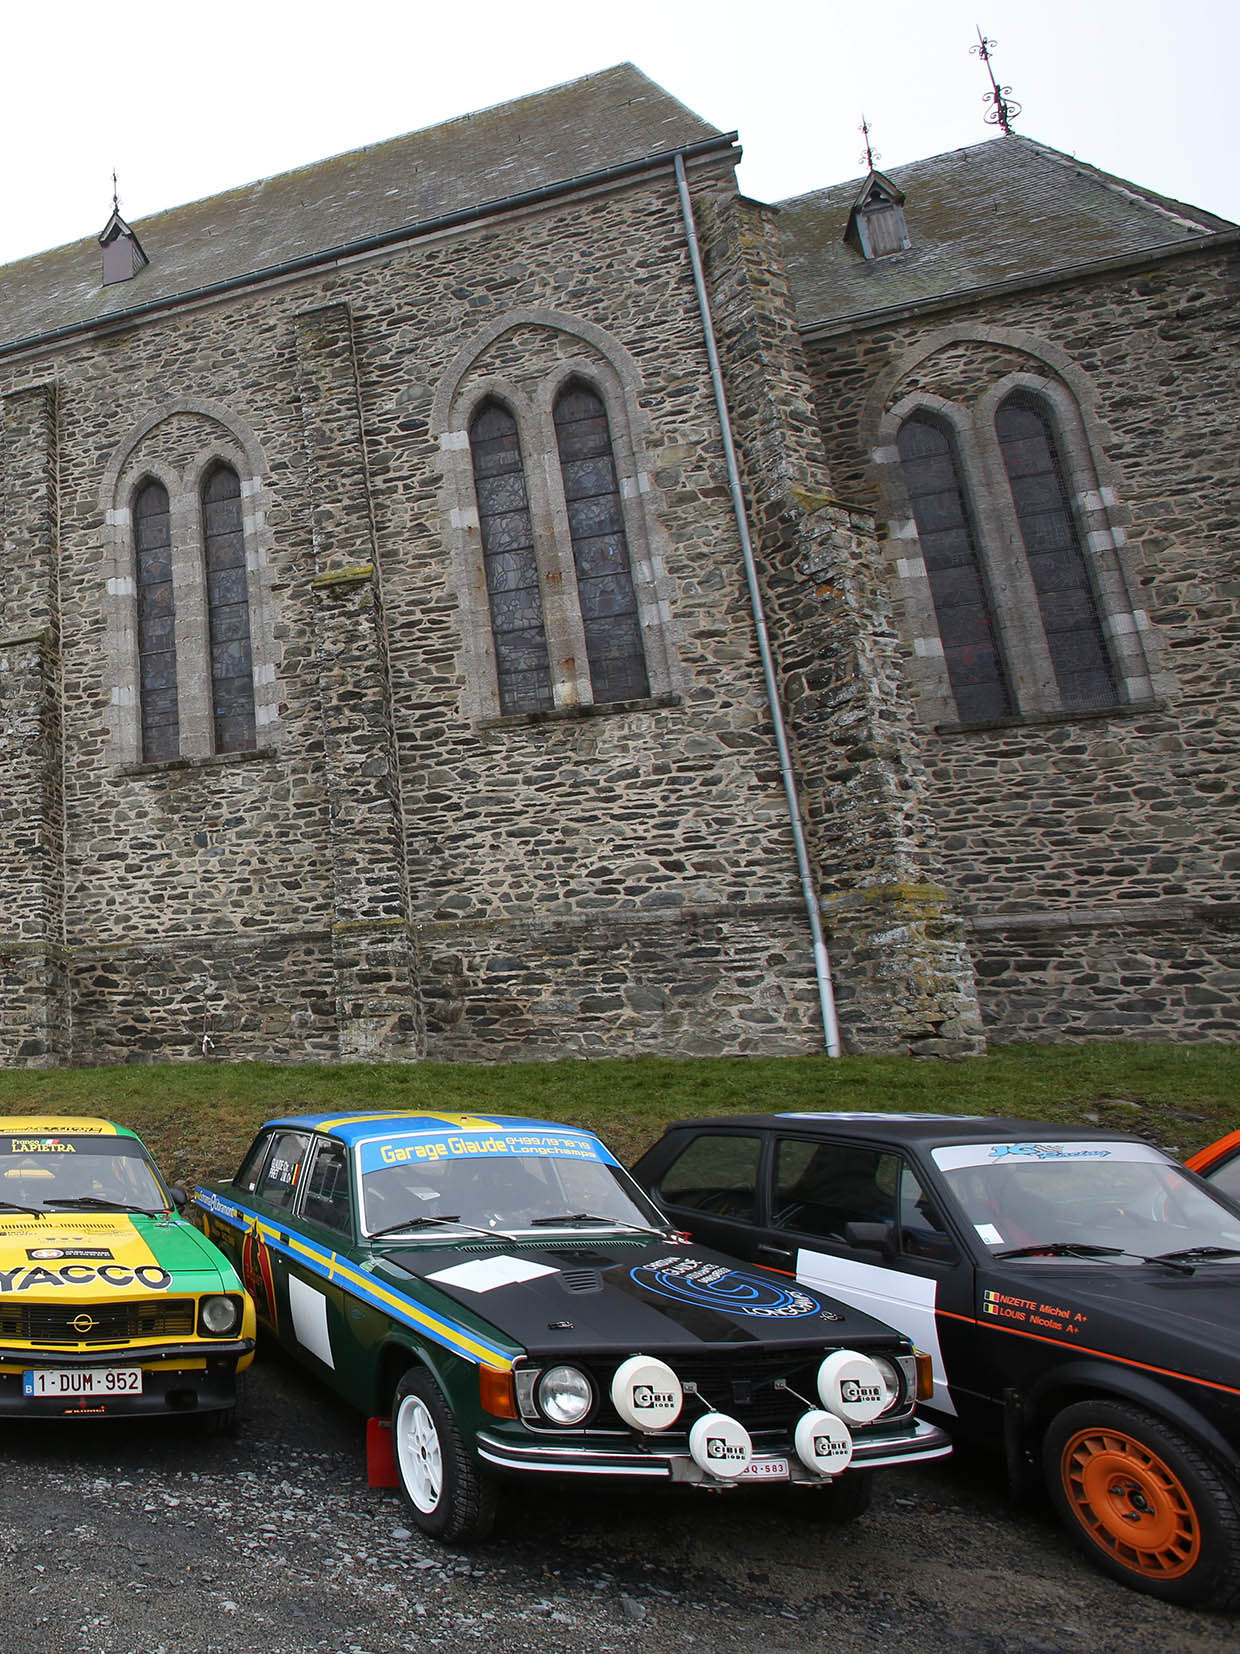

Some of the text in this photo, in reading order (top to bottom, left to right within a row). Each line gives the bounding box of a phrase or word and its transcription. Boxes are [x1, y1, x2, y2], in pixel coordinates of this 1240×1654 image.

[11, 1144, 76, 1153] LAPIETRA
[381, 1136, 509, 1163] Garage Glaude
[510, 1145, 597, 1159] Longchamps
[999, 1295, 1038, 1311] NIZETTE
[1039, 1304, 1072, 1319] Michel
[999, 1308, 1027, 1321] LOUIS
[1029, 1315, 1064, 1330] Nicolas
[39, 1371, 139, 1393] 1-DUM-952
